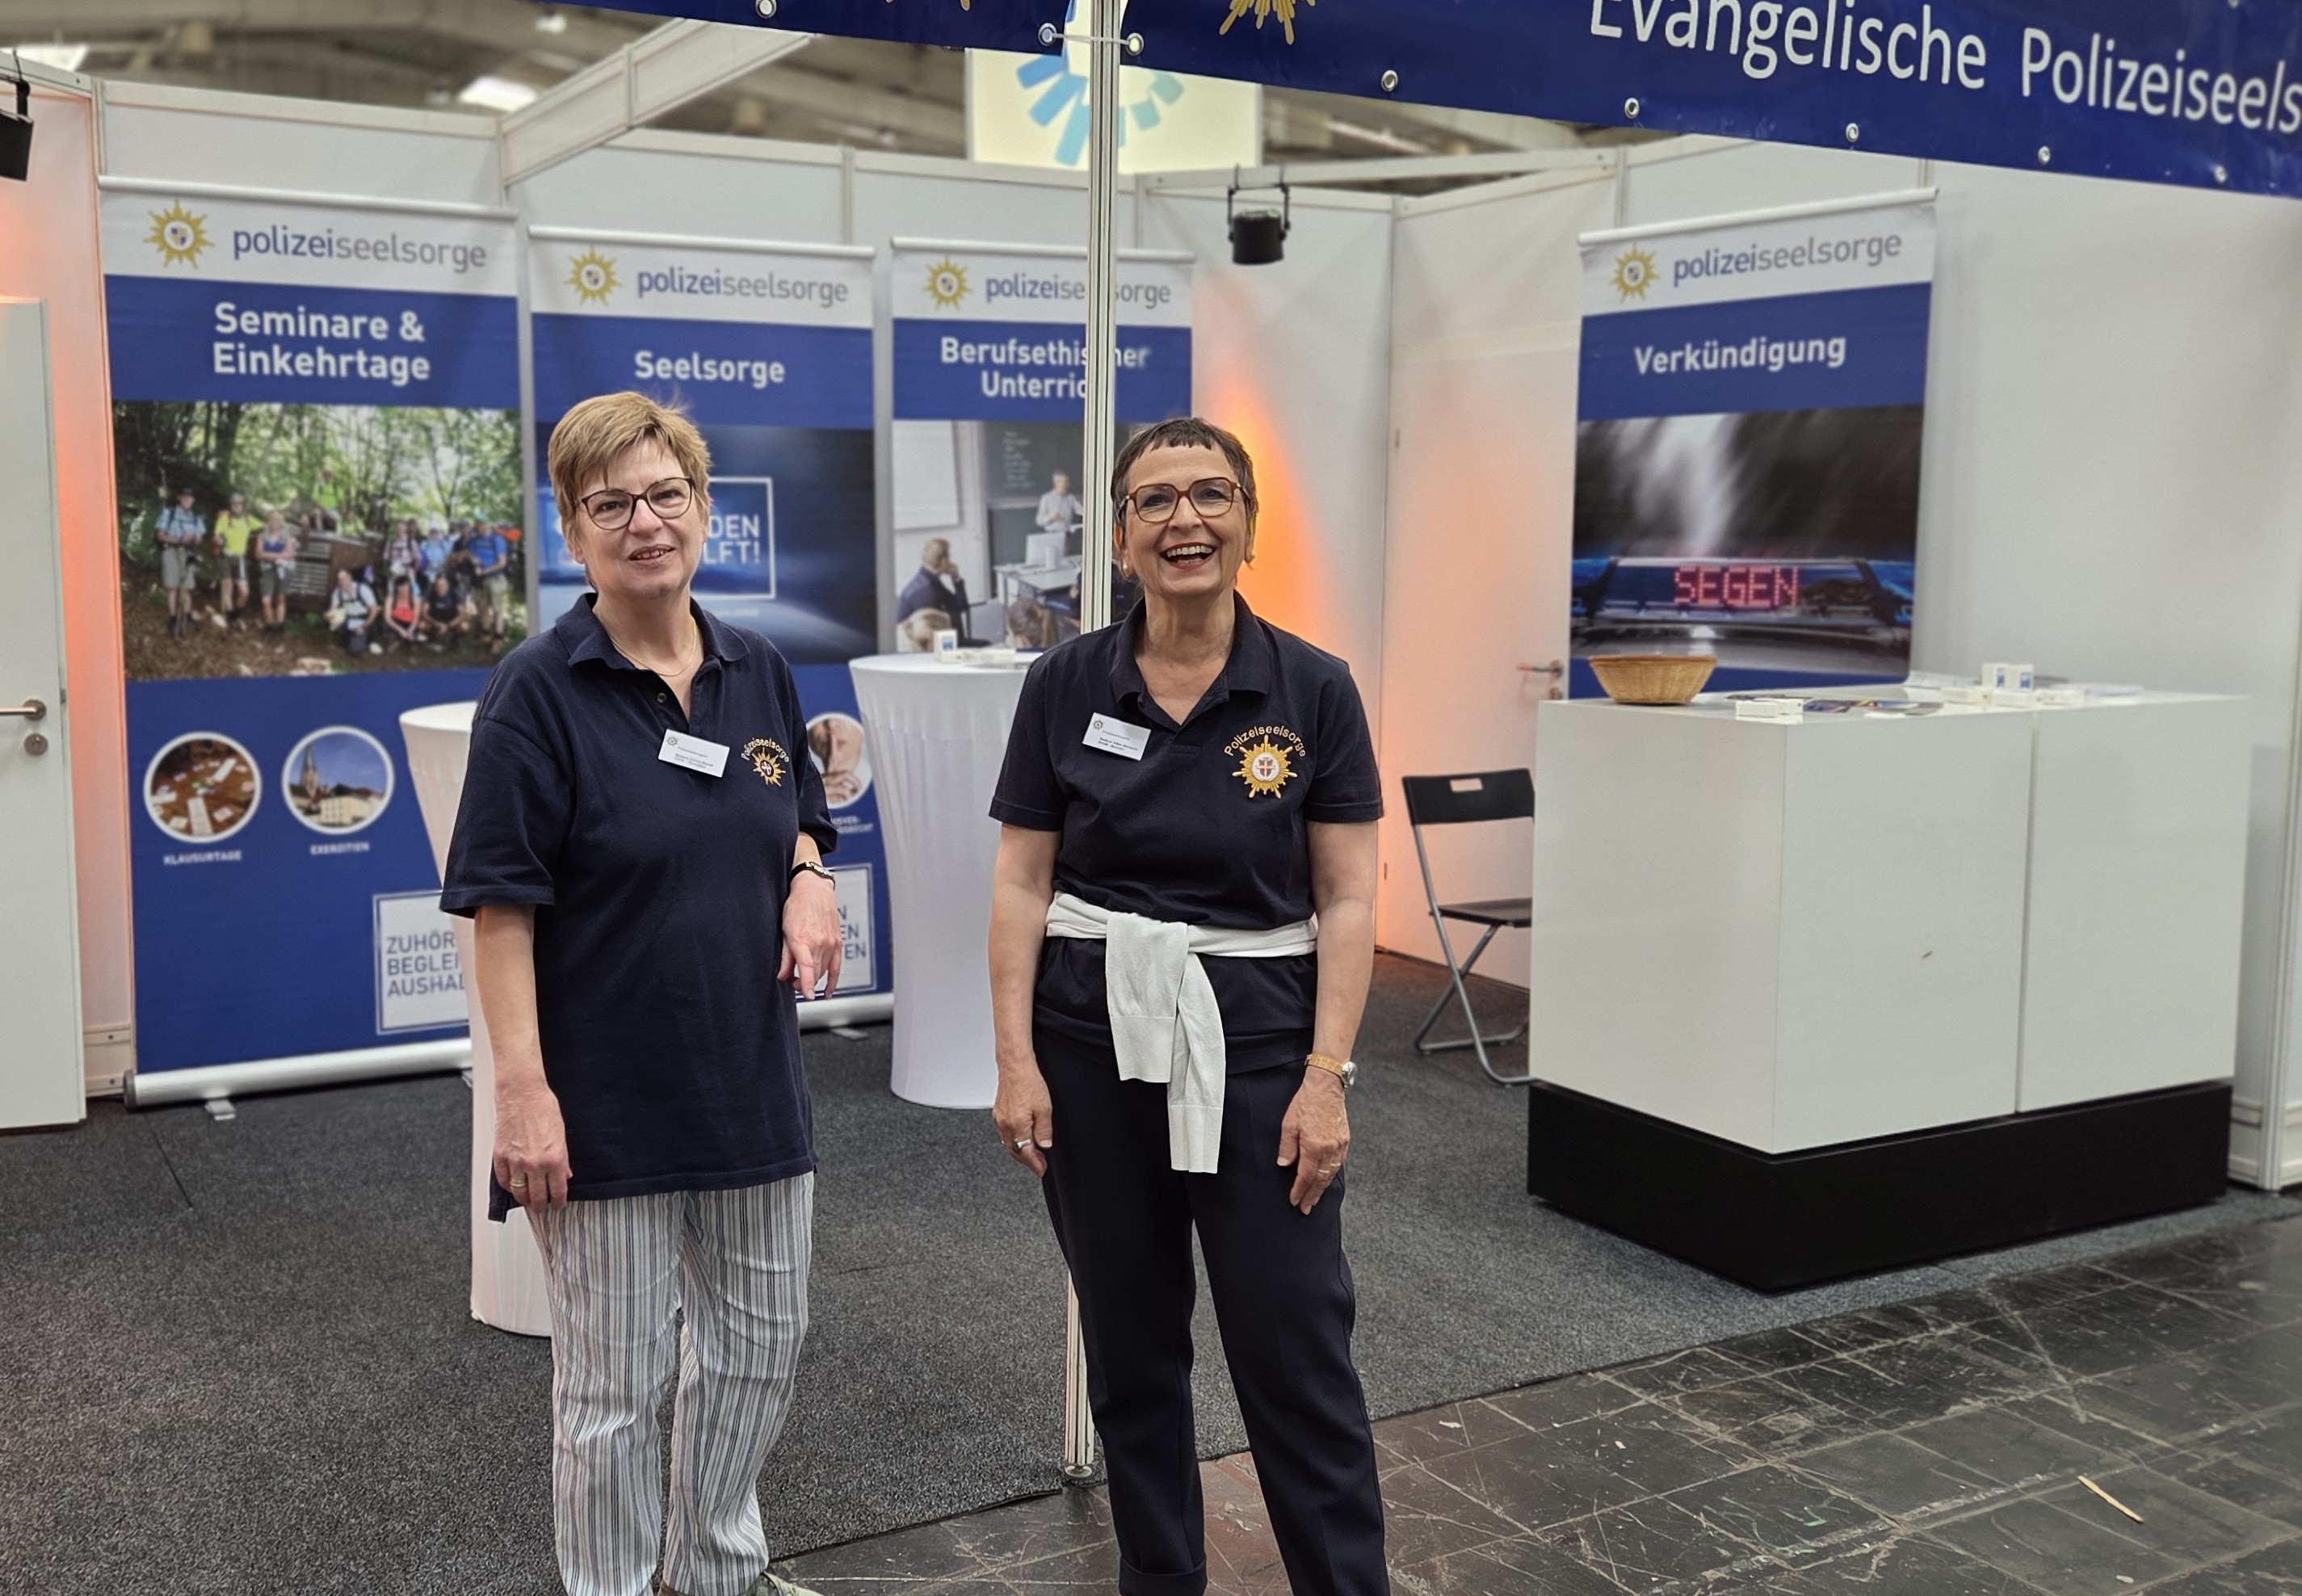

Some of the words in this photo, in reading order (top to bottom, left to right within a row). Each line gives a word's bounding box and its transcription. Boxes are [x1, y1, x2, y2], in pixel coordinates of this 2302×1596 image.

[2022, 27, 2302, 133] Polizeiseels
[233, 225, 488, 274] polizeiseelsorge
[1673, 233, 1902, 288] polizeiseelsorge
[637, 267, 849, 309] polizeiseelsorge
[985, 273, 1172, 309] polizeiseorge
[214, 301, 389, 341] Seminare
[399, 311, 426, 342] &
[212, 342, 431, 387] Einkehrtage
[634, 350, 787, 388] Seelsorge
[940, 336, 1149, 368] Berufsethier
[1634, 335, 1847, 375] Verkündigung
[981, 370, 1086, 399] Unterric
[708, 514, 760, 539] DEN
[703, 540, 760, 565] LFT!
[1673, 565, 1799, 607] SEGEN
[741, 737, 790, 762] Polizeiseelsorge
[1224, 725, 1306, 758] Polizeiseelsorge
[385, 928, 456, 955] ZUHÖR
[387, 951, 459, 976] BEGLEI
[387, 973, 466, 998] AUSHAL
